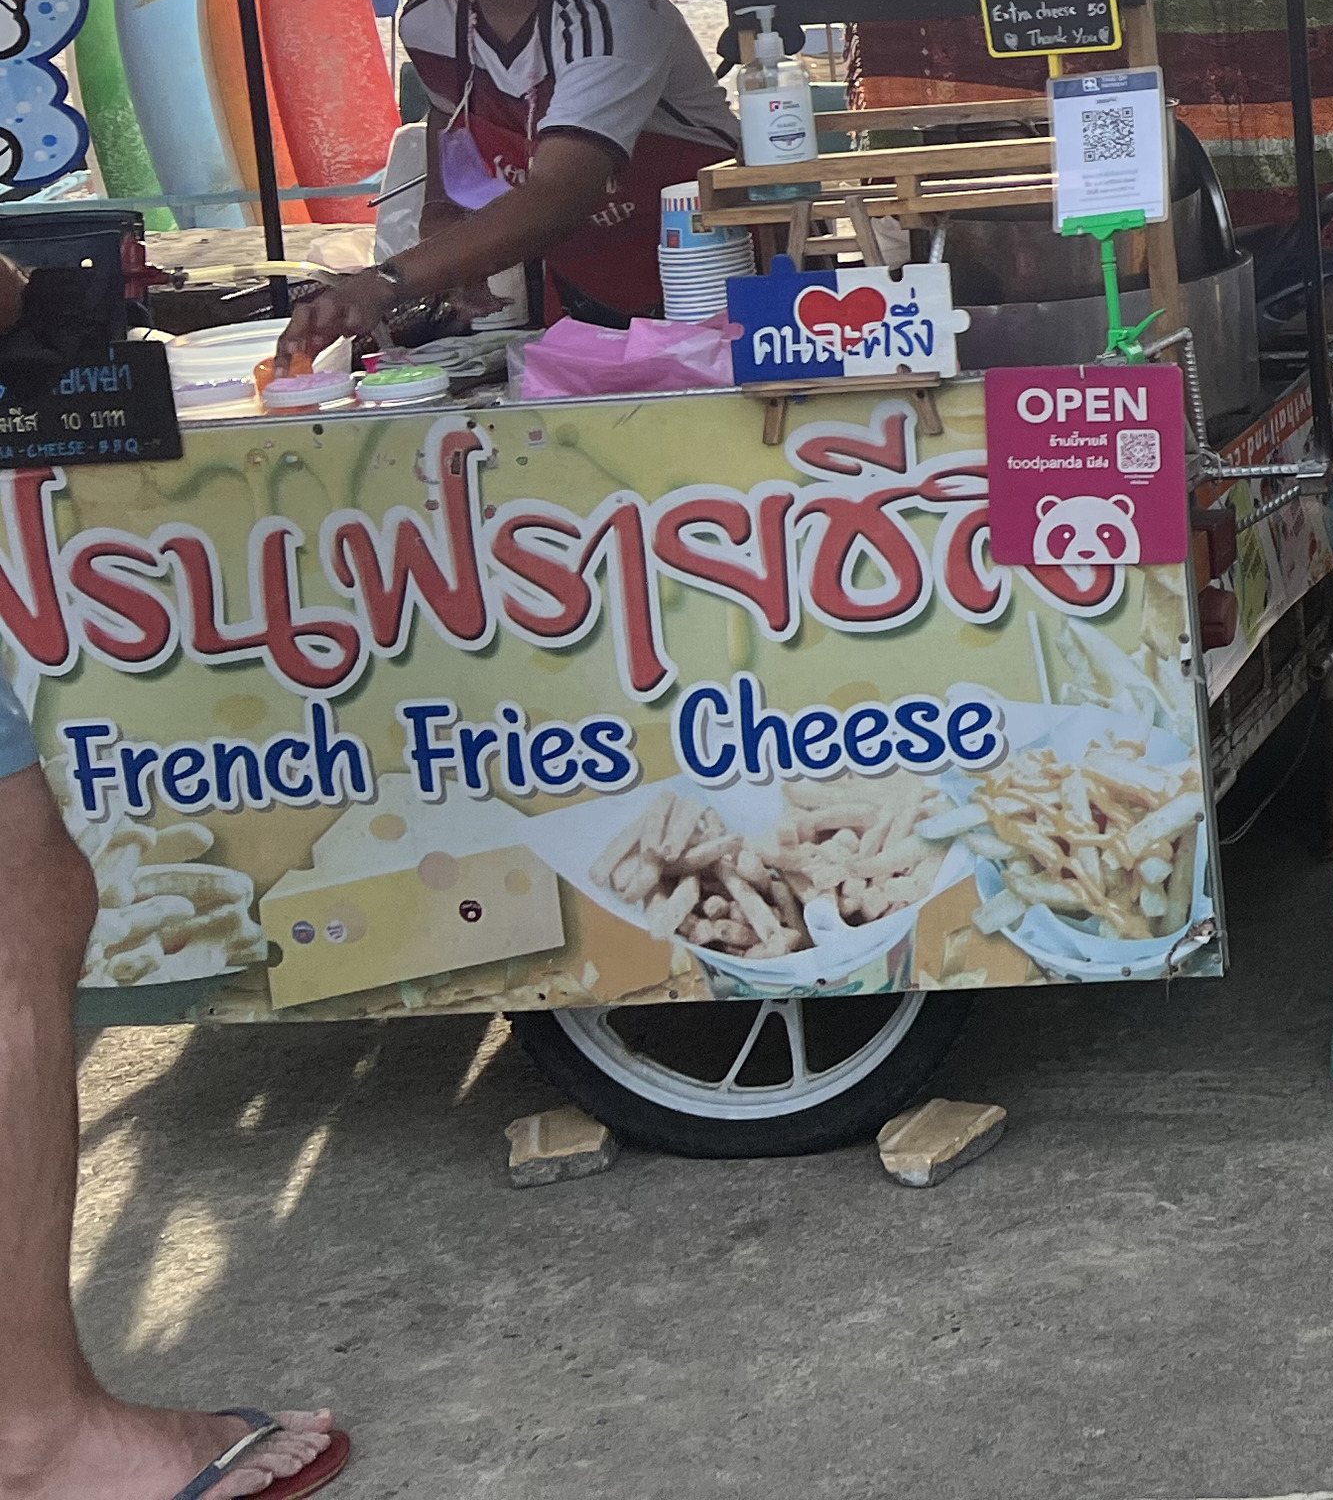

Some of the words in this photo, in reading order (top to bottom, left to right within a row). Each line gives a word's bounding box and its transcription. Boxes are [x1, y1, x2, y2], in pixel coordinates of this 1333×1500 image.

[992, 1, 1032, 23] Extra
[1087, 2, 1107, 17] 50
[1026, 26, 1067, 46] Thank
[1017, 387, 1148, 423] OPEN
[60, 412, 82, 430] 10
[1007, 456, 1083, 472] foodpanda
[62, 701, 366, 811] French
[403, 704, 631, 793] Fries
[679, 677, 997, 780] Cheese
